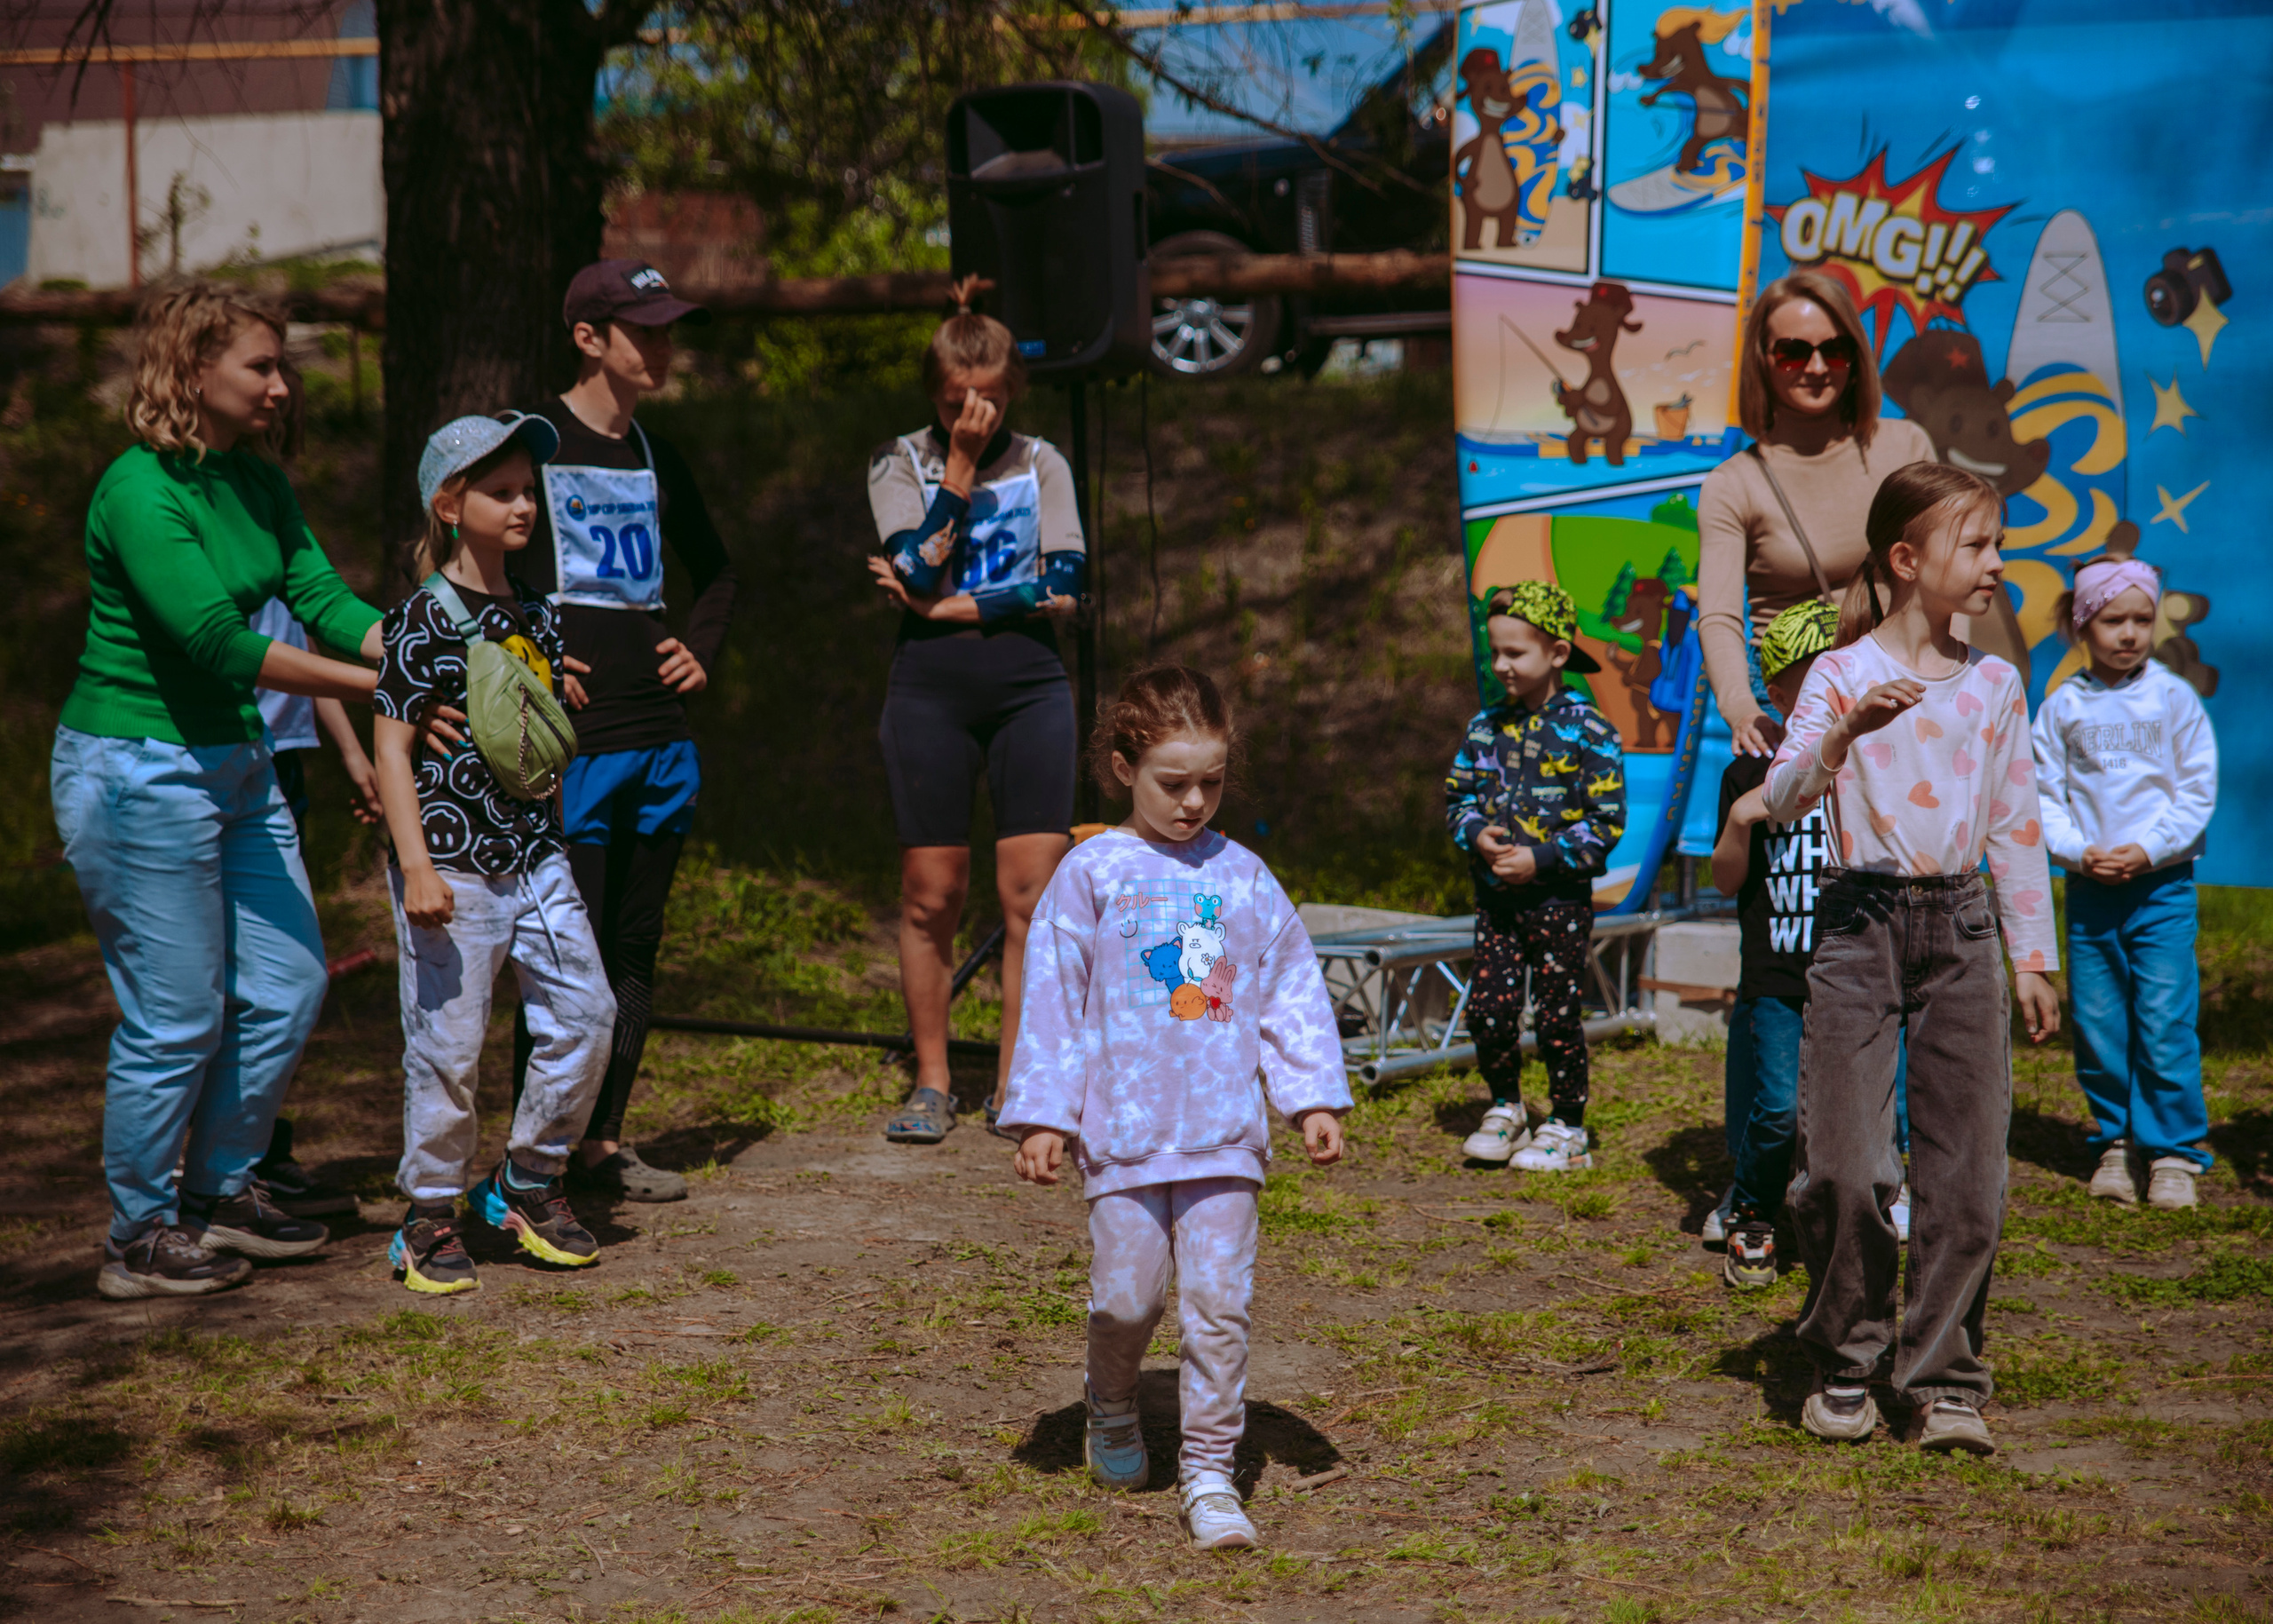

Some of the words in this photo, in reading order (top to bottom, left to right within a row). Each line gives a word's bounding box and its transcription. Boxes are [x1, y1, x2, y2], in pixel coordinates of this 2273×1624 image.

[1780, 190, 1987, 303] OMG!!!
[590, 522, 655, 582] 20
[1115, 891, 1168, 913] クルー
